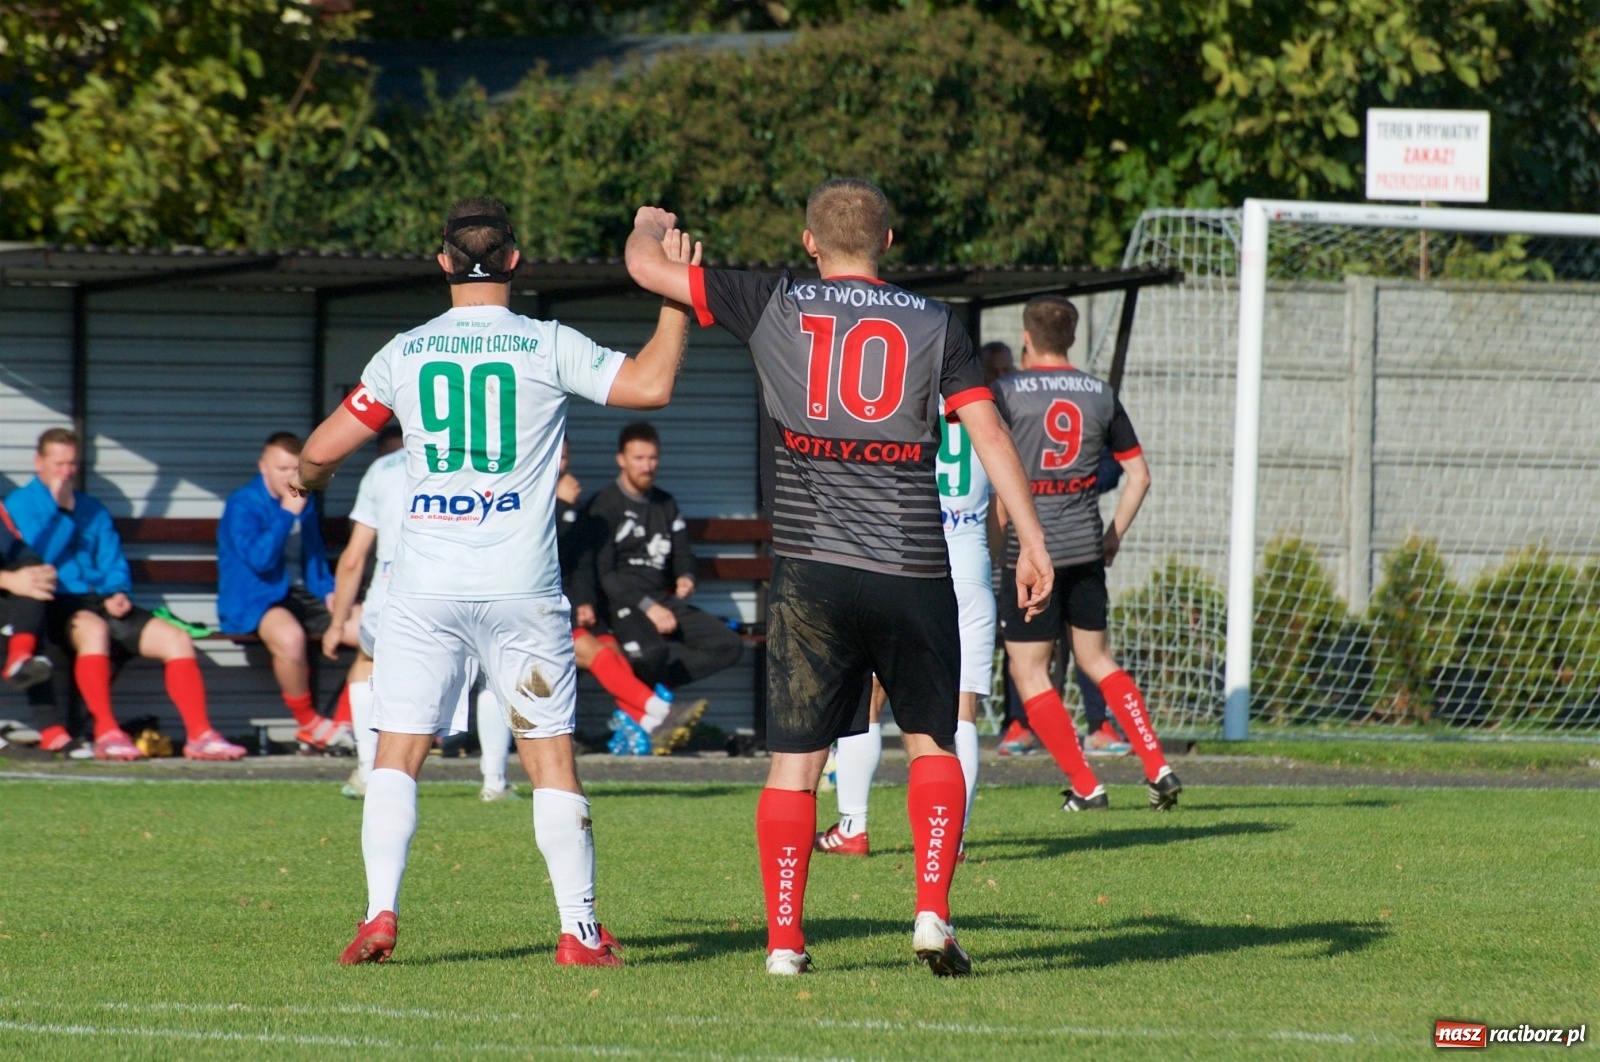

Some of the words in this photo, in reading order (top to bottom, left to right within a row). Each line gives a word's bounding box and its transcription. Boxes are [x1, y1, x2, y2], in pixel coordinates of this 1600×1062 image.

[1377, 122, 1412, 140] TEREN
[1417, 123, 1479, 141] PRYWATNY
[1403, 147, 1455, 165] ZAKAZ!
[822, 285, 926, 310] TWORKÓW
[427, 335, 482, 354] POLONIA
[487, 334, 539, 353] ŁAZISKA
[800, 312, 908, 422] 10
[1014, 378, 1038, 392] LKS
[1040, 376, 1102, 393] TWORKÓW
[351, 387, 375, 411] C
[419, 361, 516, 474] 90
[1041, 399, 1083, 469] 9
[410, 488, 520, 527] moya
